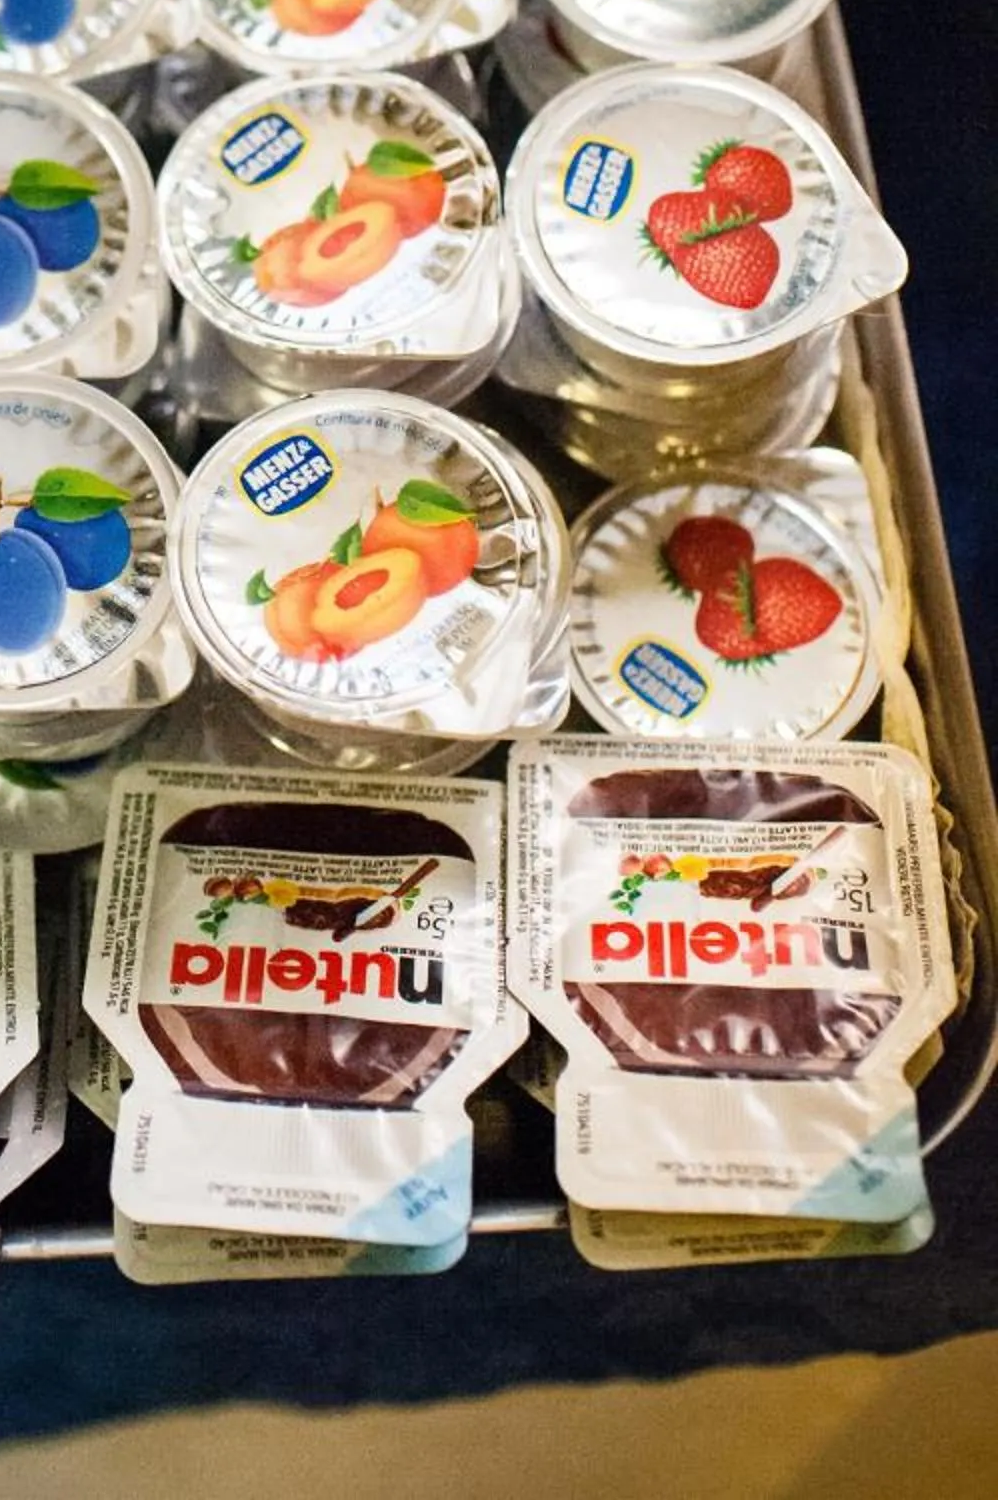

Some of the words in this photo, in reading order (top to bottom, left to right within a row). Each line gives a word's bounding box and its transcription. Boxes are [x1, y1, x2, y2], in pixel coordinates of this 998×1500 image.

[256, 455, 332, 512] GASSER
[169, 942, 444, 1005] nutella
[590, 920, 872, 977] nutella
